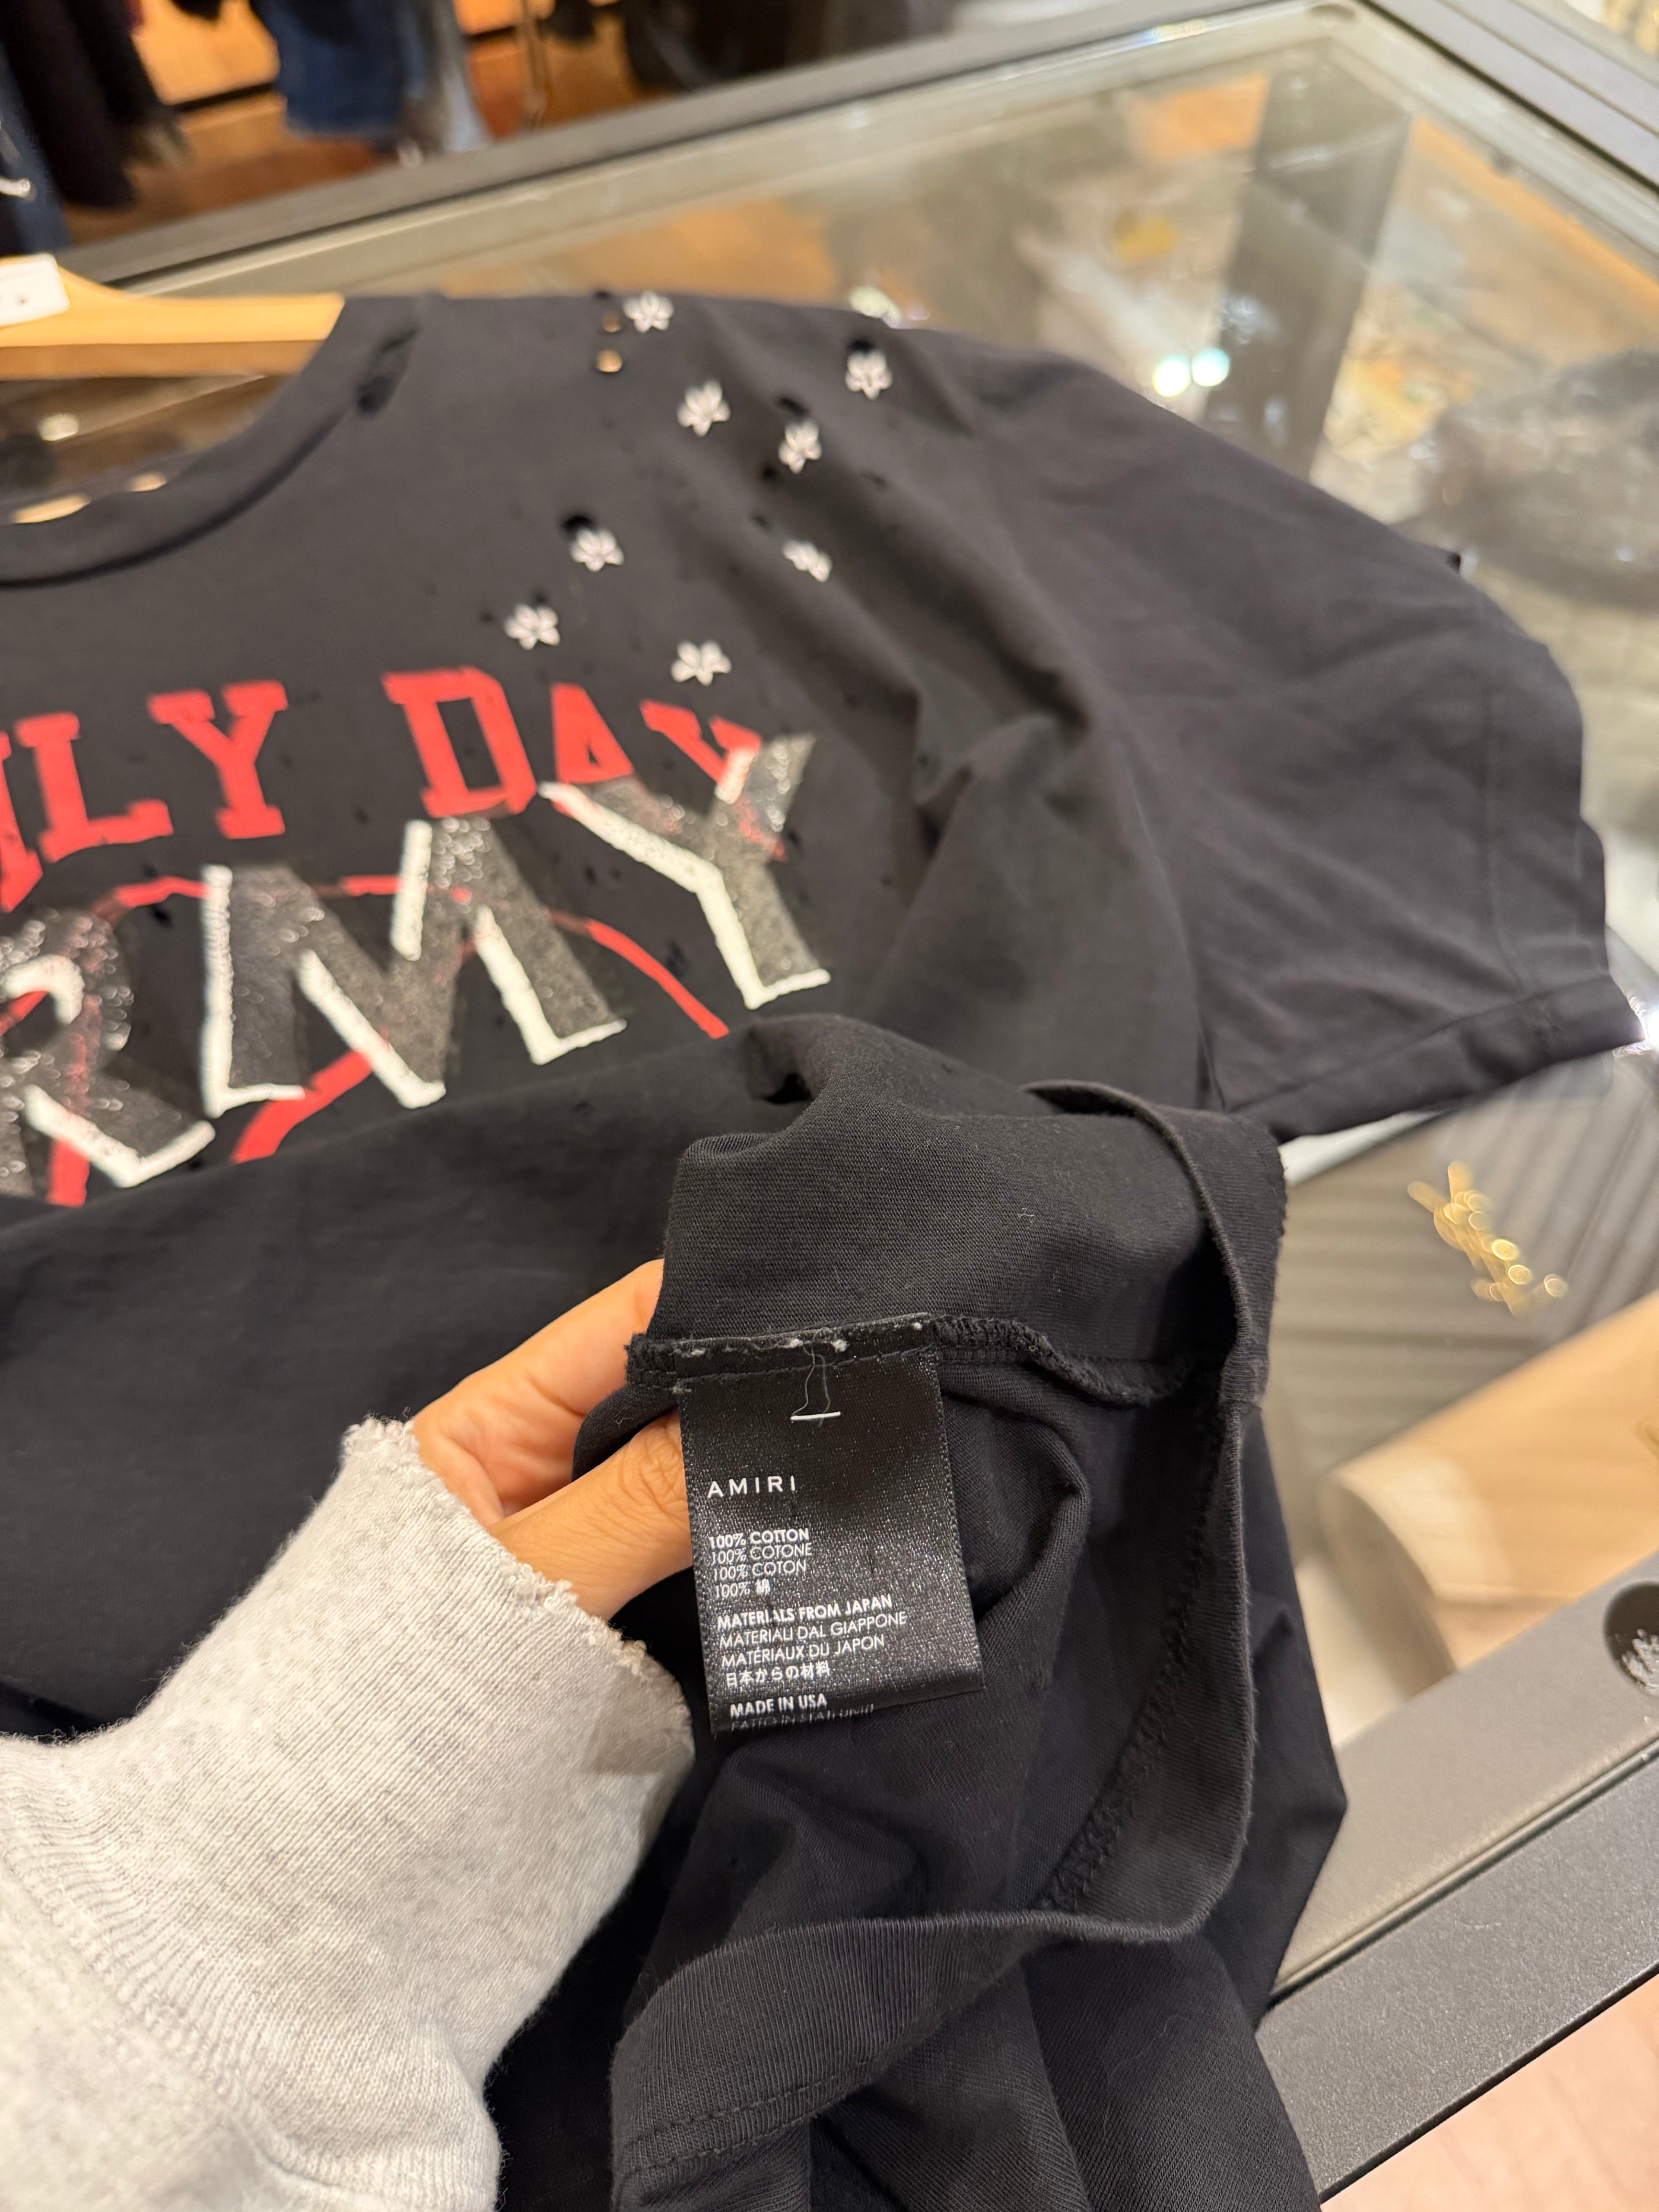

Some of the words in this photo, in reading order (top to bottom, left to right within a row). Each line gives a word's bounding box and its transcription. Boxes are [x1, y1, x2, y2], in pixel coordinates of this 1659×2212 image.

[381, 667, 763, 818] DAY
[707, 1475, 796, 1499] AMIRI
[709, 1532, 747, 1549] 100%
[750, 1528, 809, 1545] COTTON
[712, 1548, 747, 1565] 100%
[750, 1542, 813, 1561] COTONE
[713, 1564, 748, 1581] 100%
[752, 1560, 807, 1577] COTON
[715, 1582, 750, 1599] 100%
[717, 1608, 795, 1631] MATERIALS
[799, 1603, 841, 1621] FROM
[845, 1593, 893, 1615] JAPAN
[720, 1625, 793, 1649] MATERIALI
[798, 1624, 826, 1640] DAL
[830, 1611, 907, 1637] GIAPPONE
[809, 1643, 830, 1658] DU
[834, 1634, 885, 1656] JAPON
[726, 1660, 831, 1688] 日本からの材料
[730, 1698, 775, 1719] MADE
[778, 1696, 794, 1712] IN
[798, 1693, 827, 1710] USA
